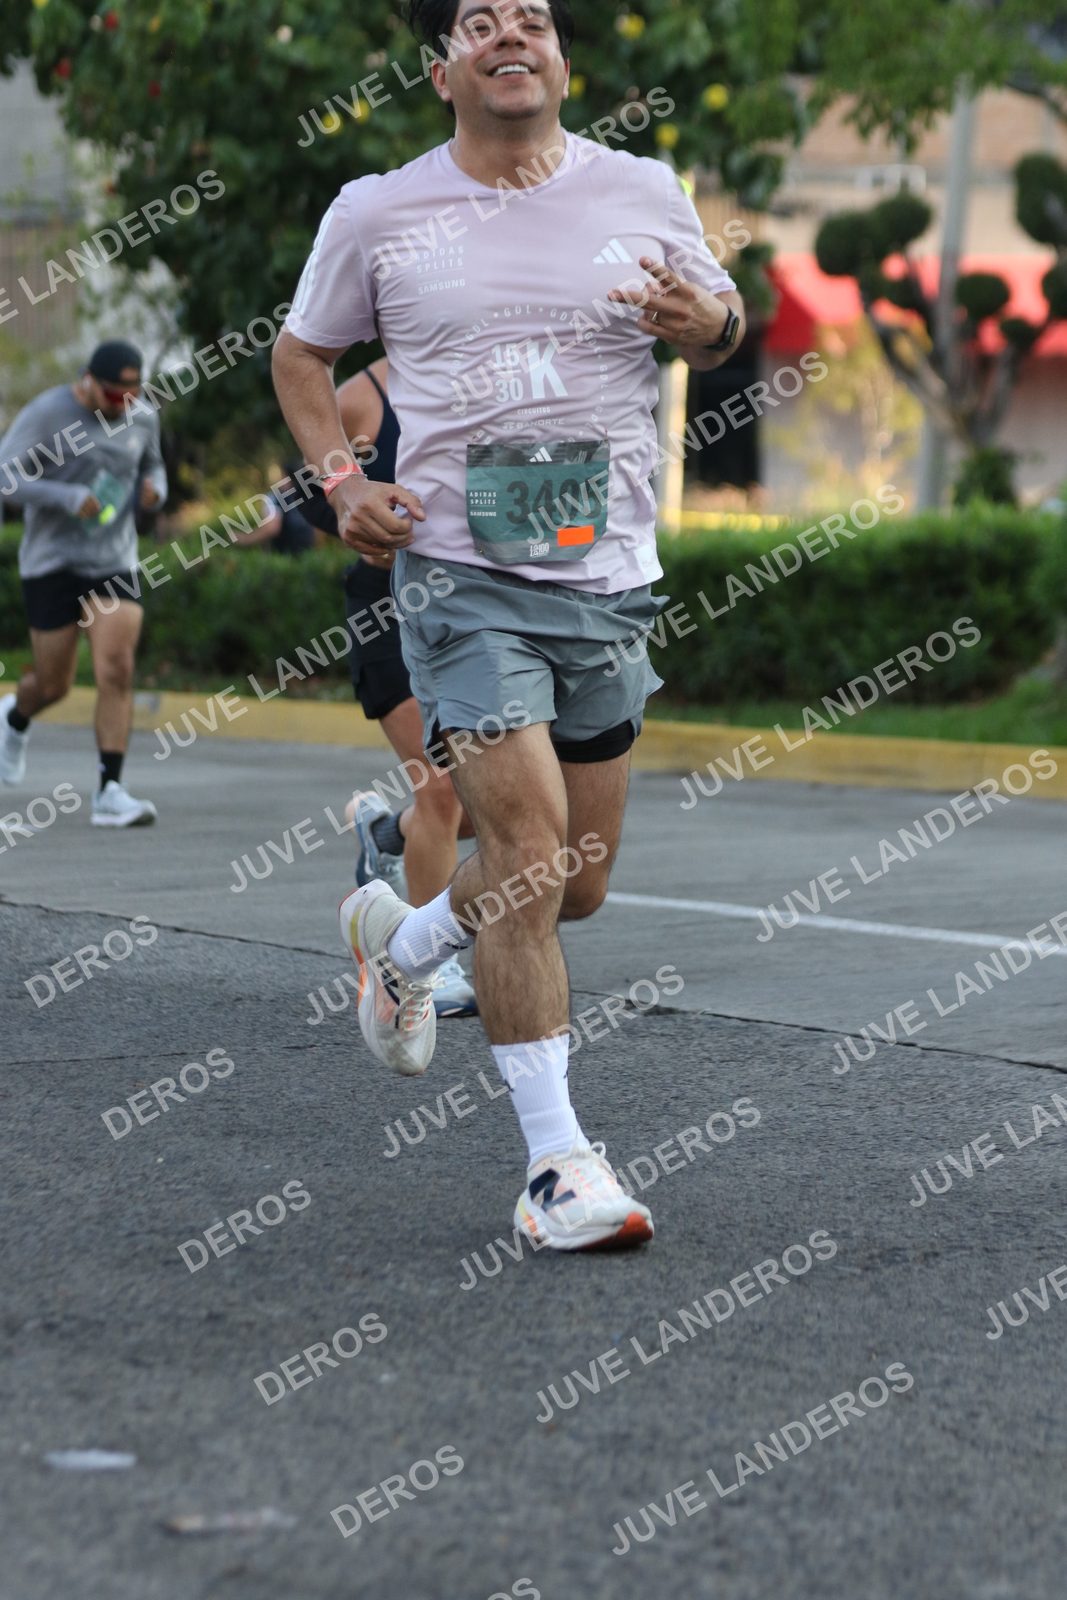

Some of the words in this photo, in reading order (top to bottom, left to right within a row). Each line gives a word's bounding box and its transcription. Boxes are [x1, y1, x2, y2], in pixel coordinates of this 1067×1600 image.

[416, 257, 463, 273] SPLITS
[418, 279, 465, 295] SAMSUNG
[490, 343, 520, 369] 15
[526, 341, 569, 400] K
[495, 377, 524, 403] 30
[516, 417, 566, 430] BANORTE
